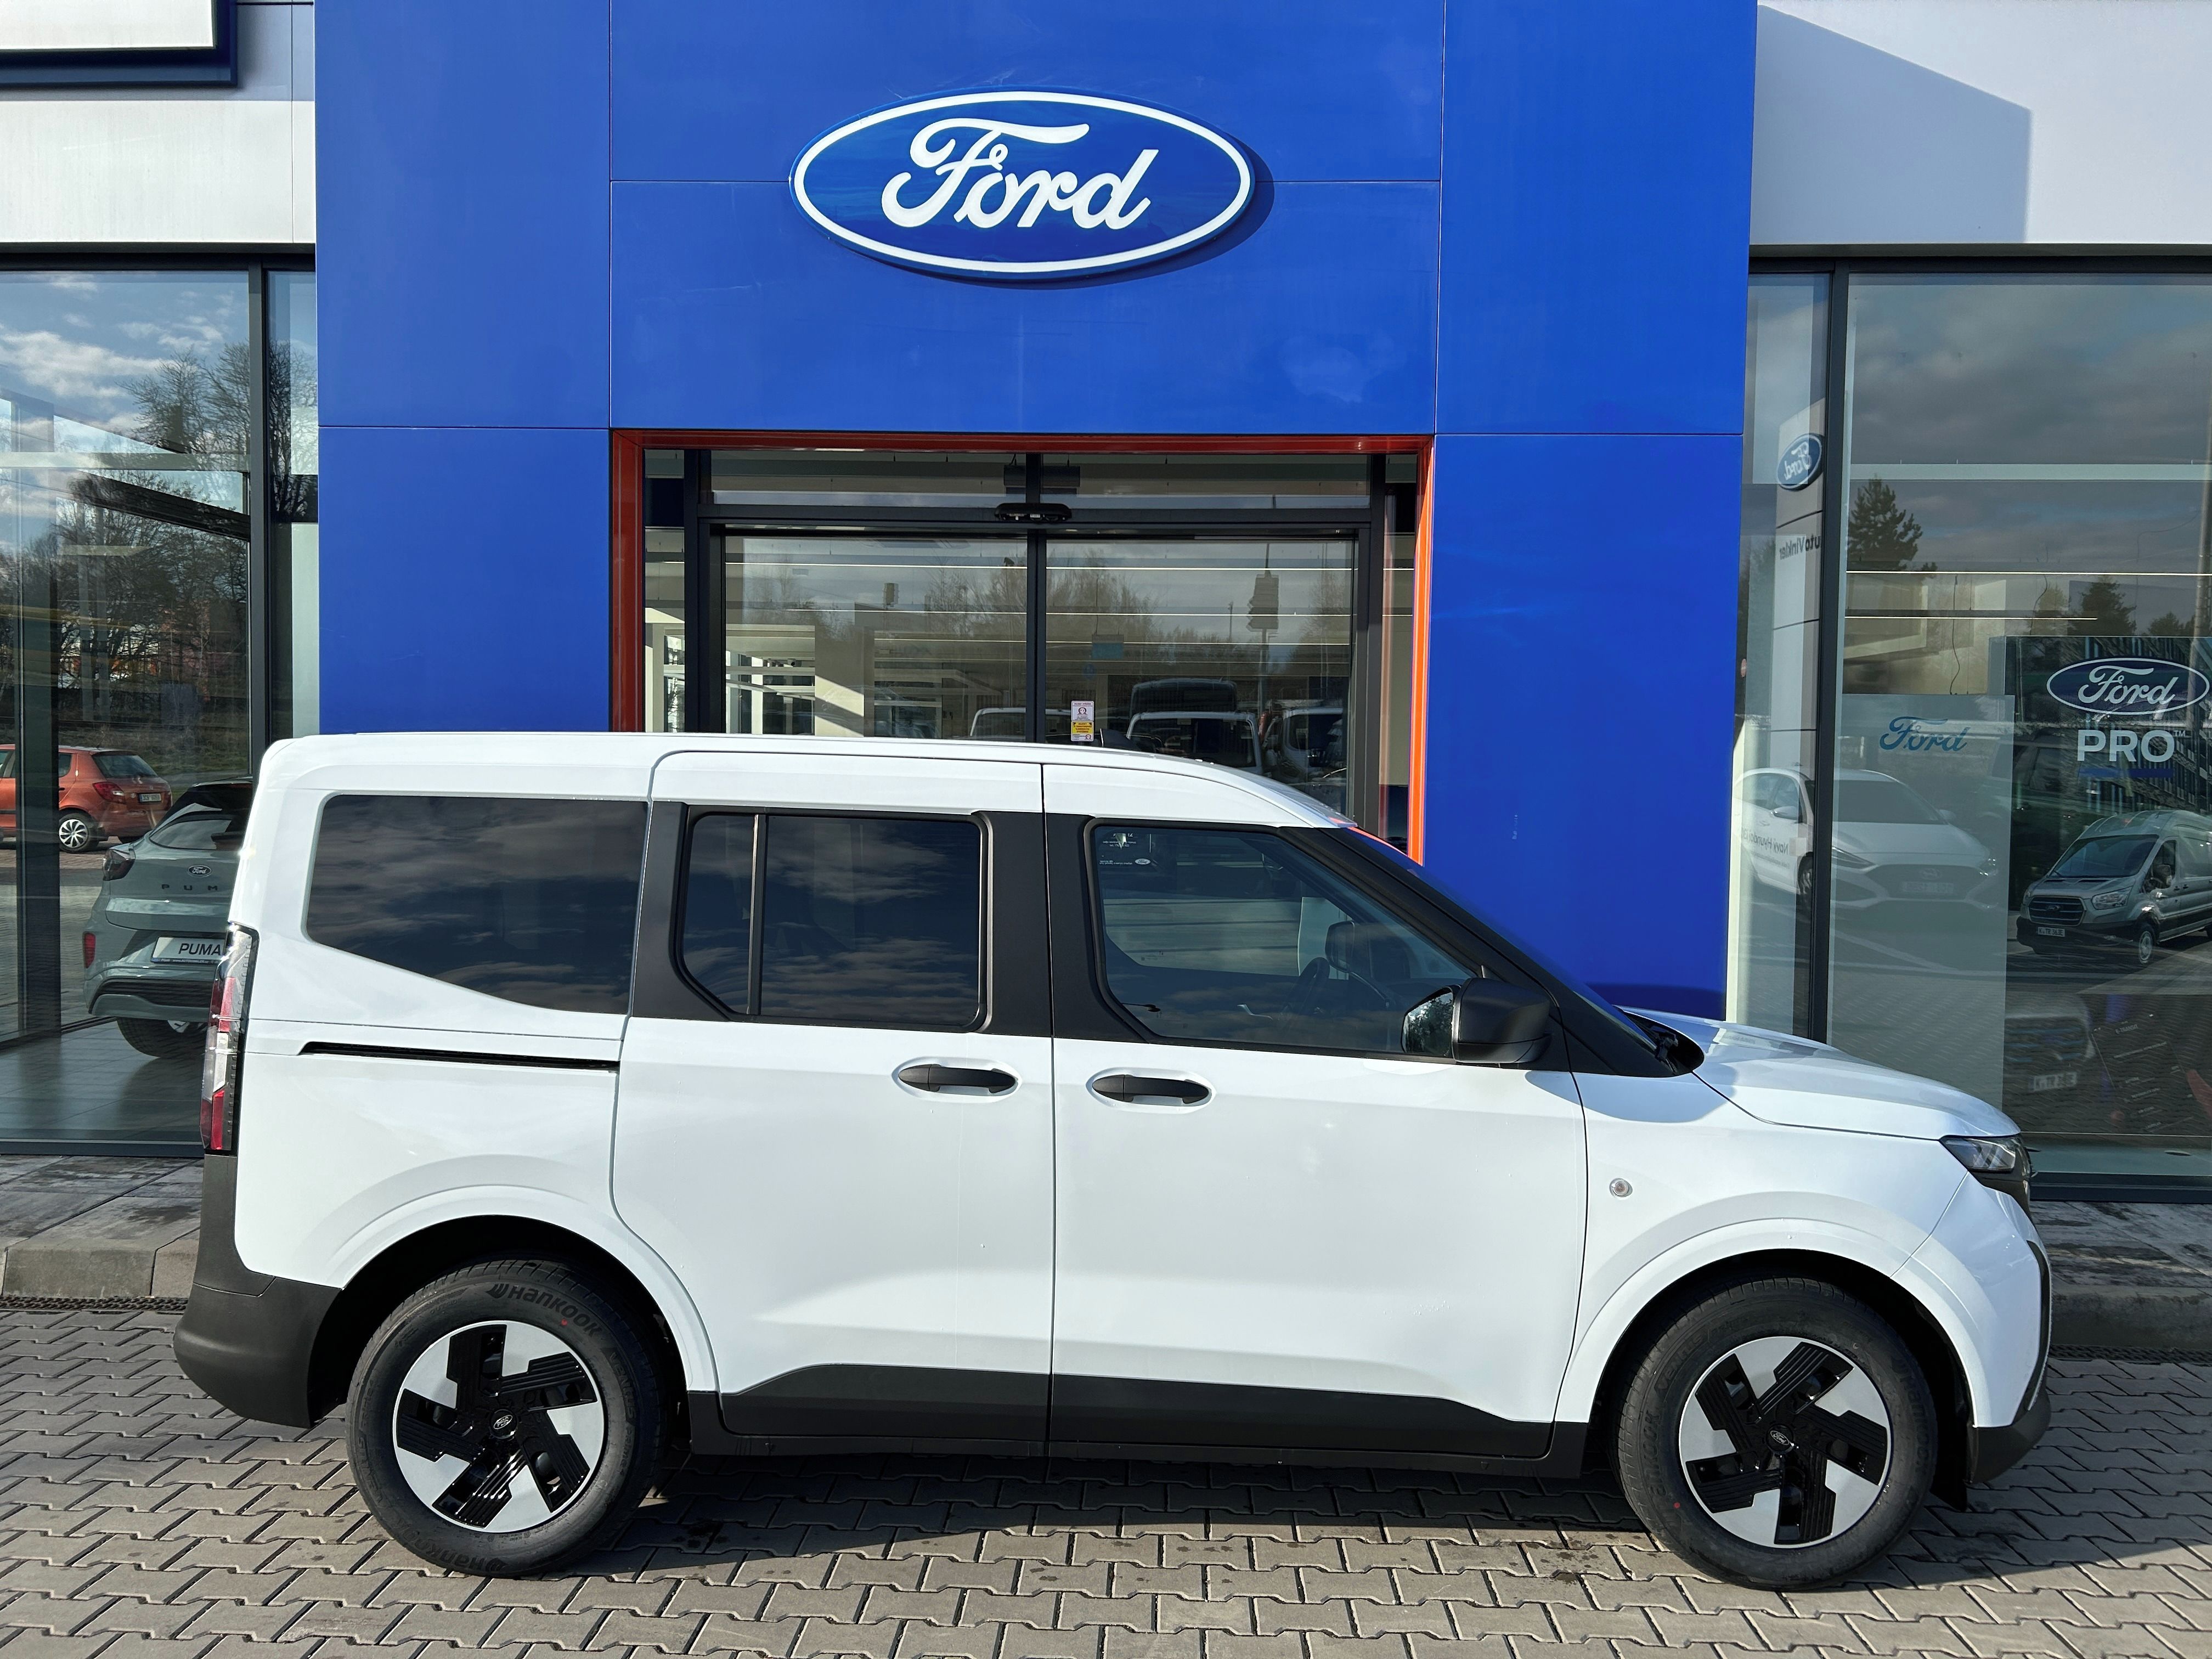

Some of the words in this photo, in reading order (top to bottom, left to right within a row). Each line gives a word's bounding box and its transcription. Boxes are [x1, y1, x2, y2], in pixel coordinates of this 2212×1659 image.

[881, 117, 1160, 230] Ford
[2078, 664, 2179, 705] Ford
[1879, 716, 1971, 752] Ford
[2077, 729, 2175, 762] PRO
[178, 943, 221, 956] PUMA
